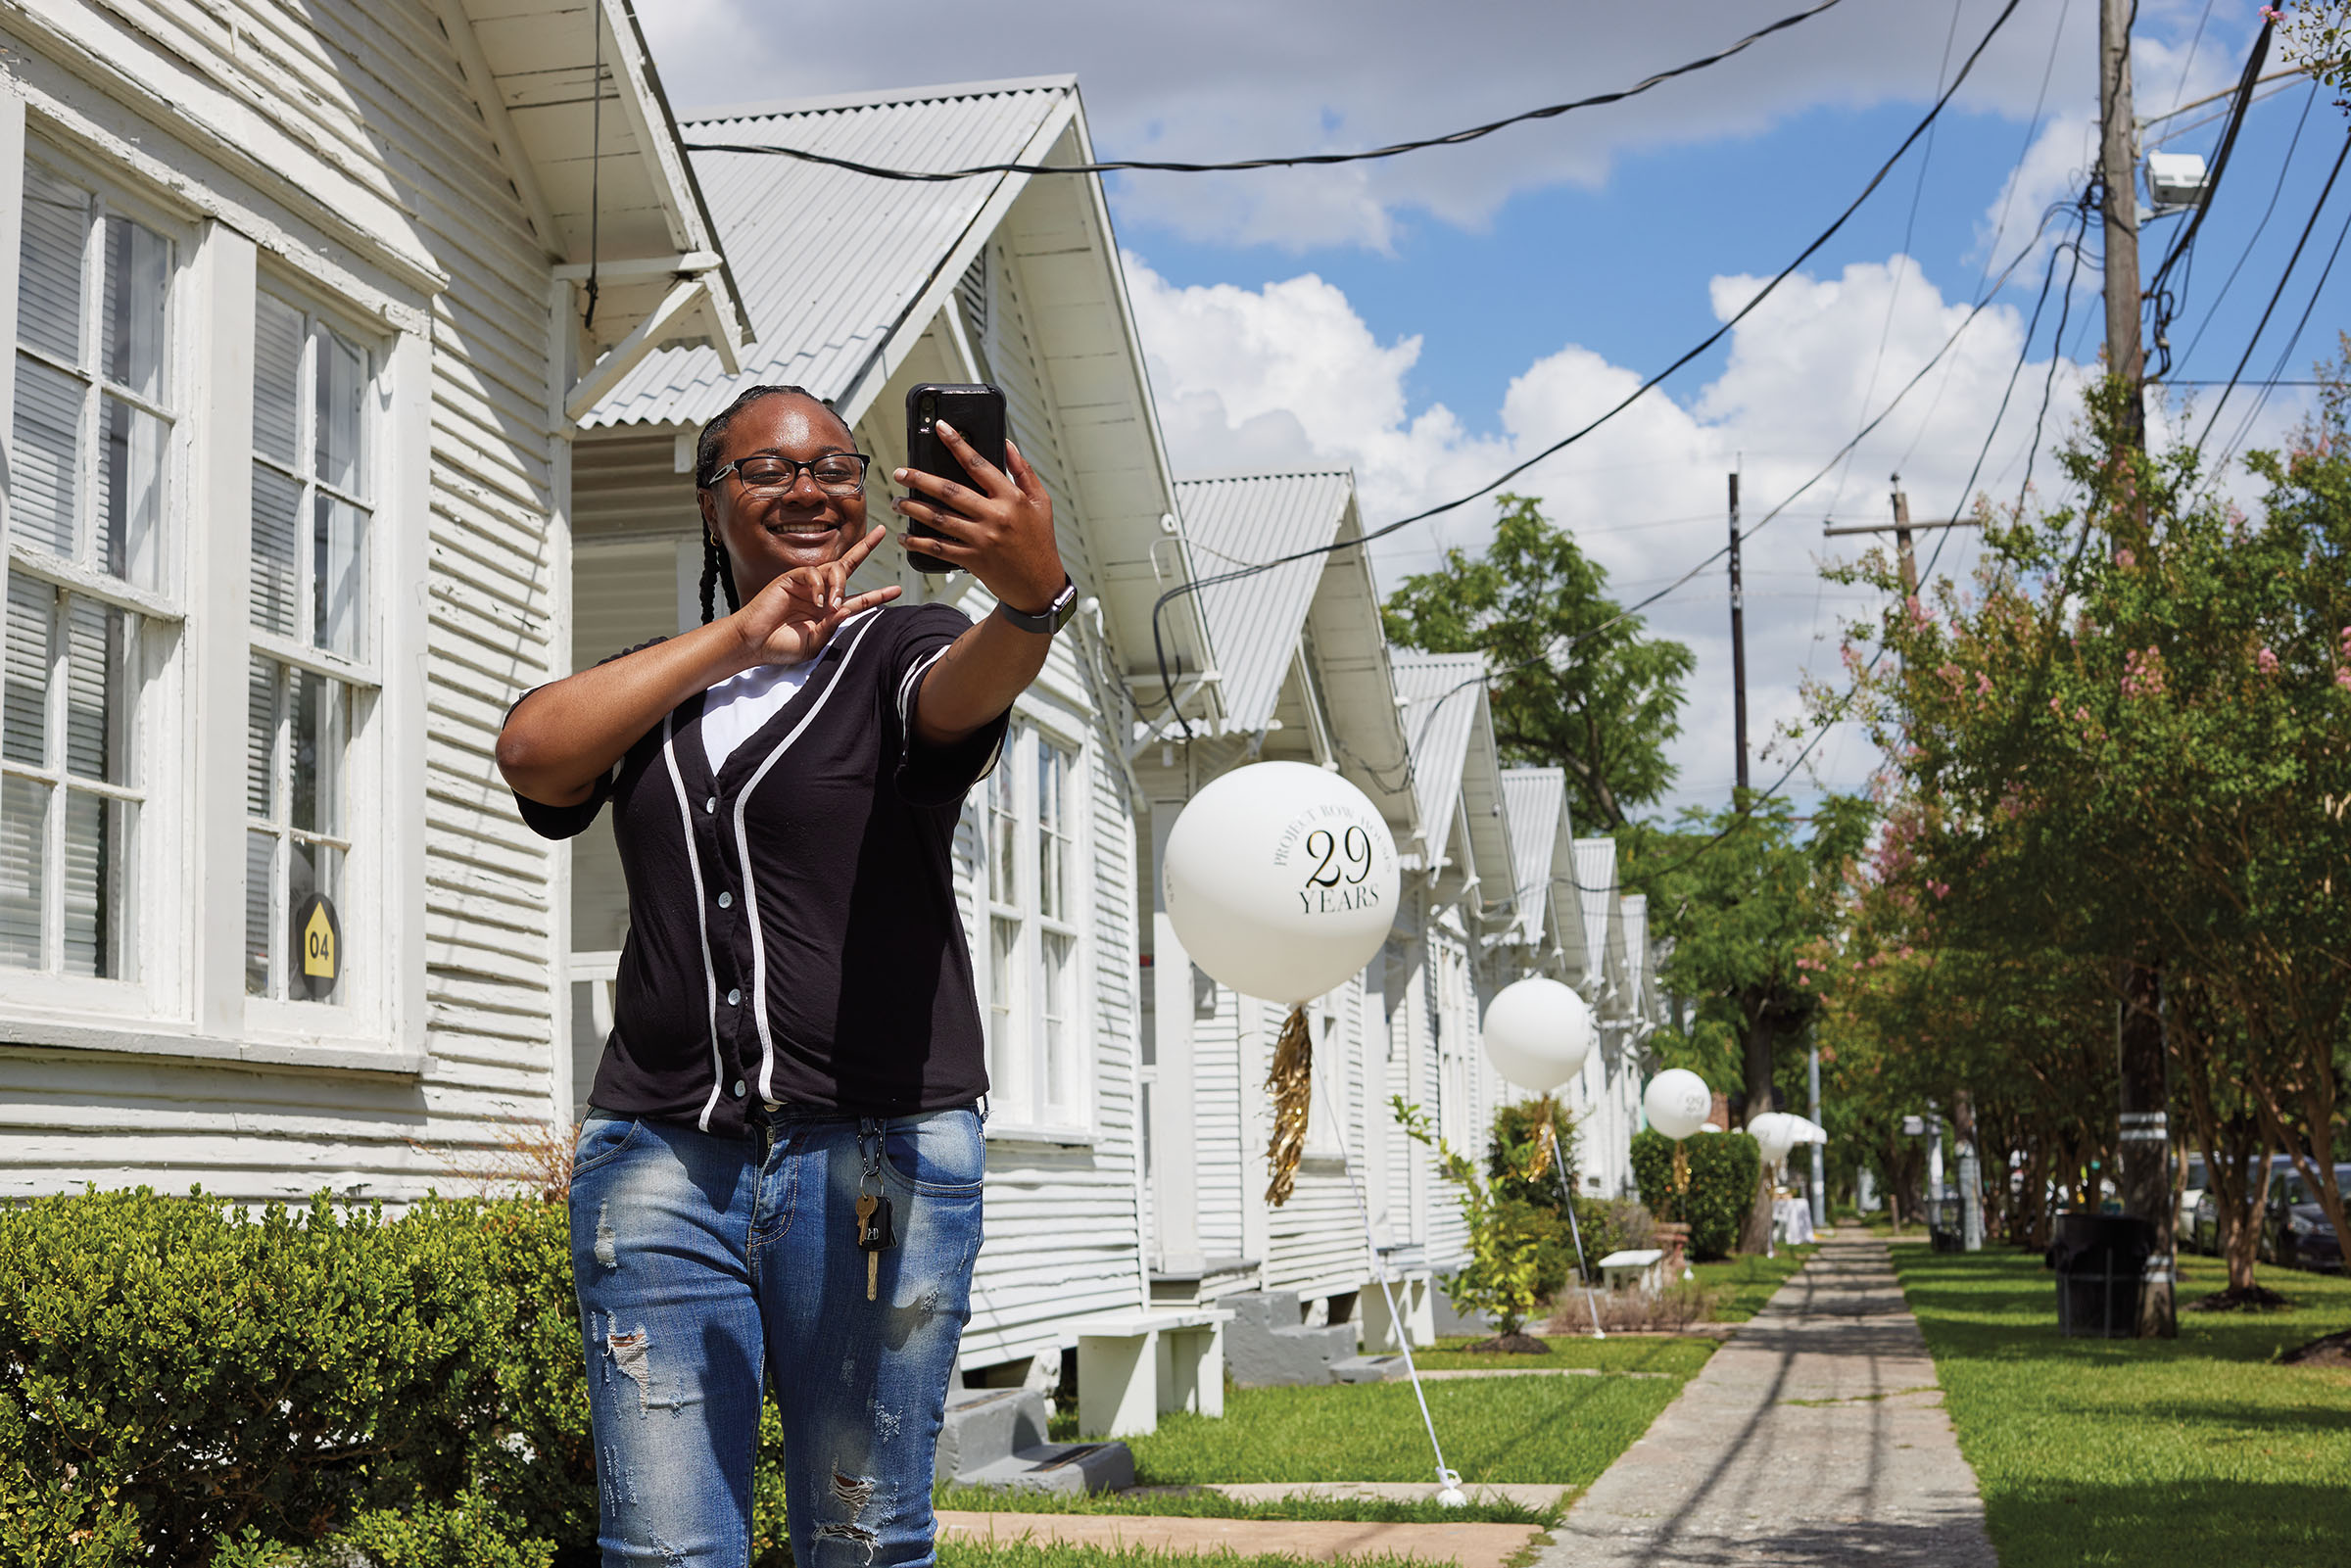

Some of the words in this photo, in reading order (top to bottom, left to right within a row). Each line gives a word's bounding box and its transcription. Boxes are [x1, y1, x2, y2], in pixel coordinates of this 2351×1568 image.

[1273, 808, 1317, 867] PROJECT
[1319, 805, 1355, 820] ROW
[1306, 825, 1371, 888] 29
[1299, 883, 1379, 914] YEARS
[310, 930, 329, 961] 04
